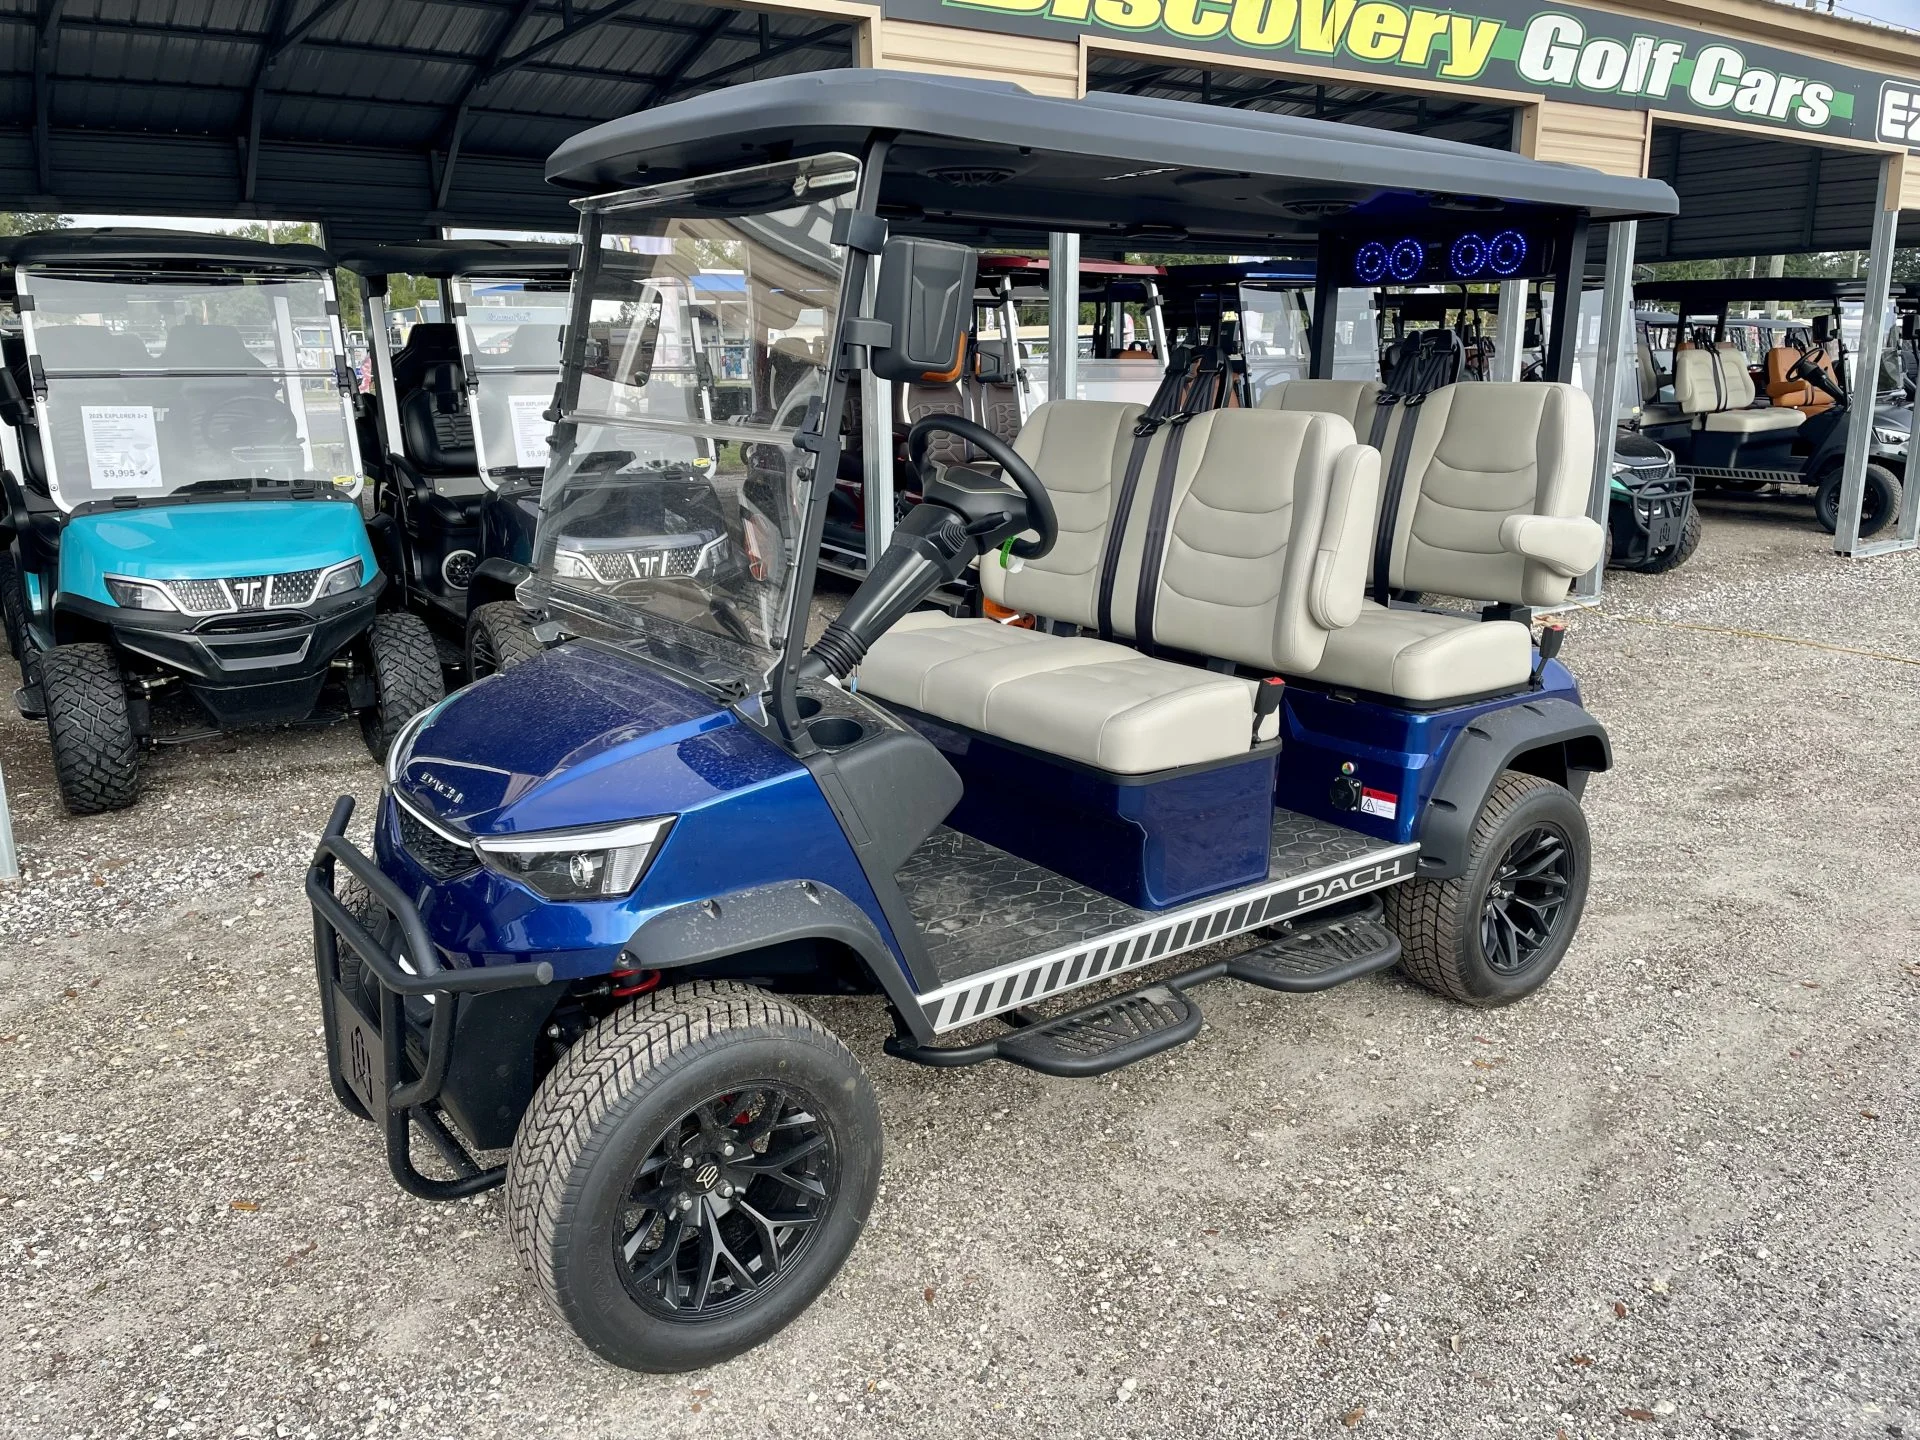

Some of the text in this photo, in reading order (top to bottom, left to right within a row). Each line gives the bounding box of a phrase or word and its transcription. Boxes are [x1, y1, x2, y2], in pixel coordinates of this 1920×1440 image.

[942, 0, 1834, 127] covery Golf Cars
[104, 469, 135, 478] $9,995
[1298, 860, 1400, 906] DACH
